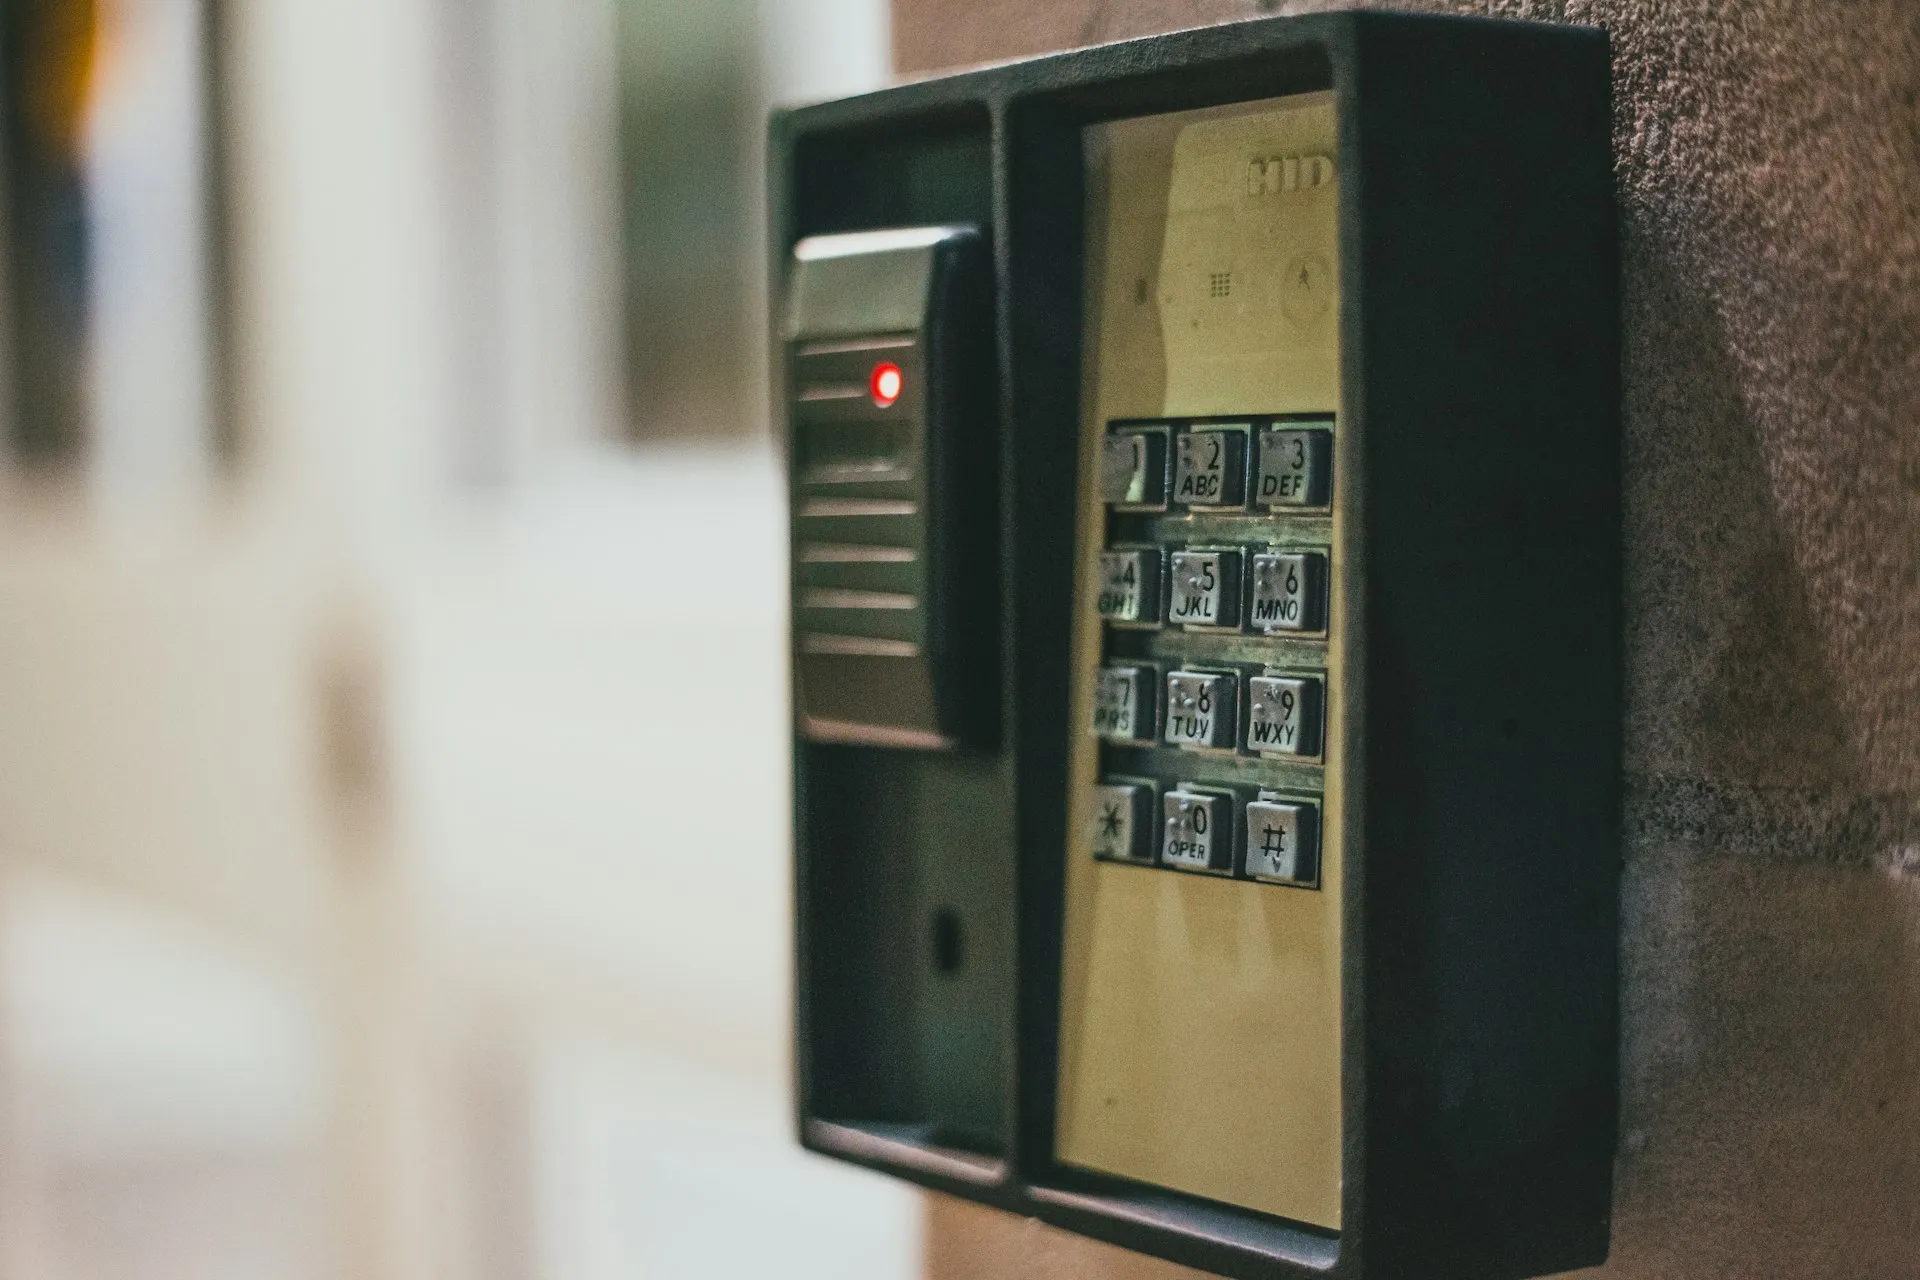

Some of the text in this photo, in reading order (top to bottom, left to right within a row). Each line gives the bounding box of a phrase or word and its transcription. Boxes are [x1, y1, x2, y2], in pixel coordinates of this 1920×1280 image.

[1132, 443, 1138, 470] 1
[1208, 440, 1220, 470] 2
[1292, 438, 1304, 470] 3
[1180, 475, 1219, 496] ABC
[1262, 475, 1304, 496] DEF
[1122, 562, 1135, 588] 4
[1202, 561, 1215, 591] 5
[1286, 564, 1298, 595] 6
[1176, 596, 1212, 617] JKL
[1256, 599, 1298, 621] MNO
[1117, 678, 1130, 706] 7
[1199, 683, 1210, 714] 8
[1281, 690, 1294, 720] 9
[1172, 716, 1209, 739] TUV
[1254, 721, 1295, 745] WXY
[1168, 840, 1205, 860] OPER
[1261, 823, 1286, 857] #
